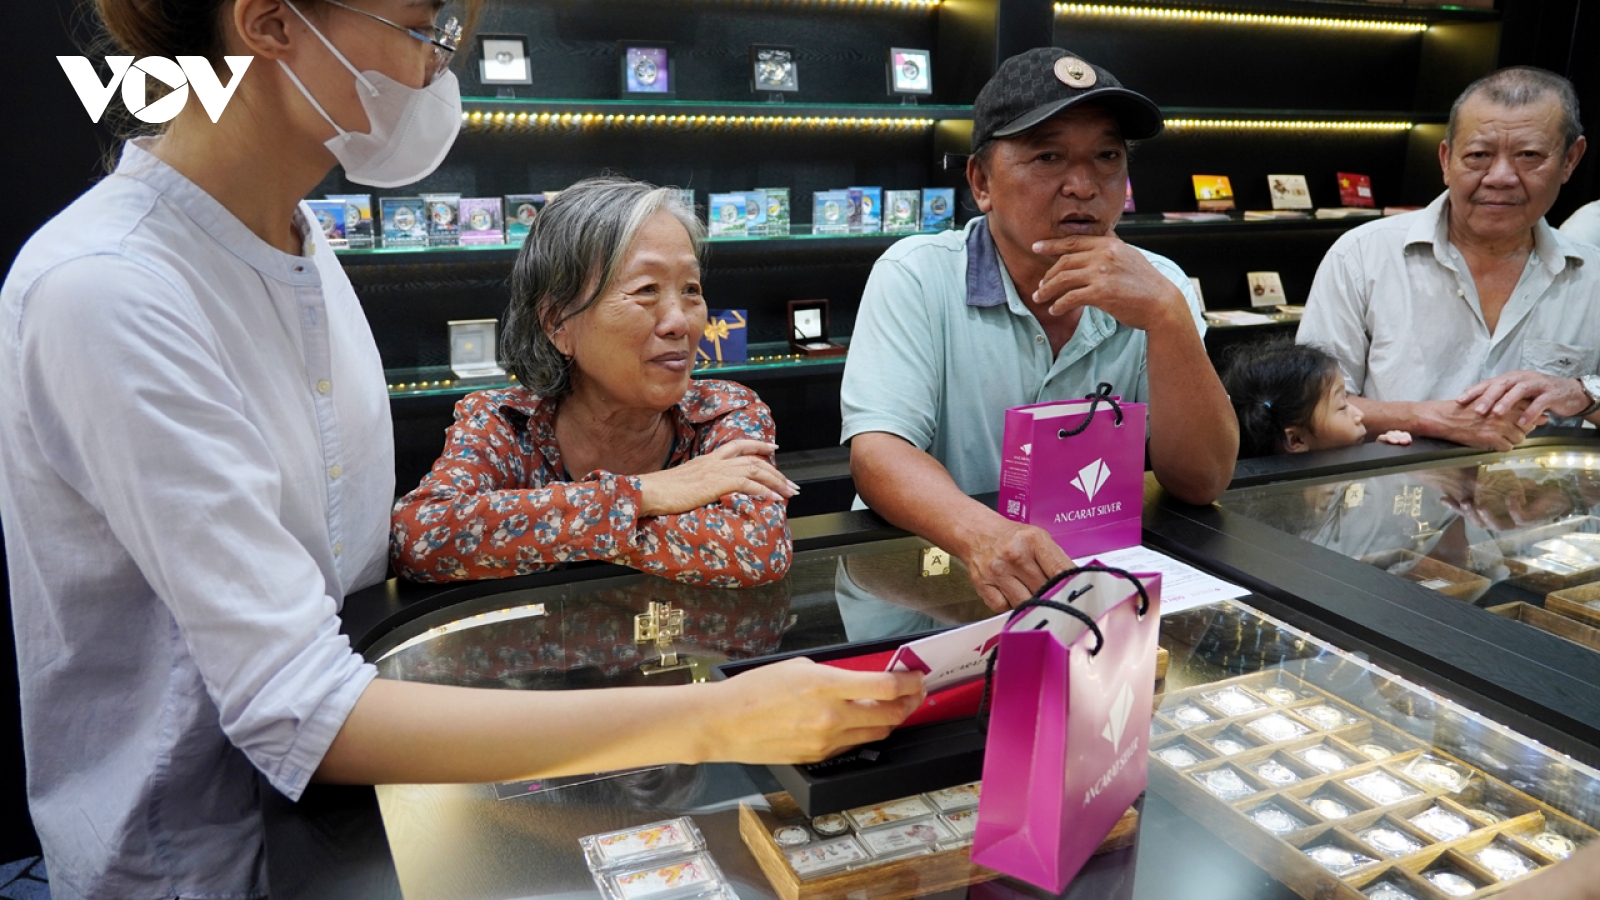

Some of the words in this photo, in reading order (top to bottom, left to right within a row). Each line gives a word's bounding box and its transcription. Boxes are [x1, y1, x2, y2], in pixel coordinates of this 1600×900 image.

[1054, 506, 1096, 524] ANCARAT
[1097, 501, 1122, 516] SILVER
[1082, 750, 1120, 809] ANCARAT
